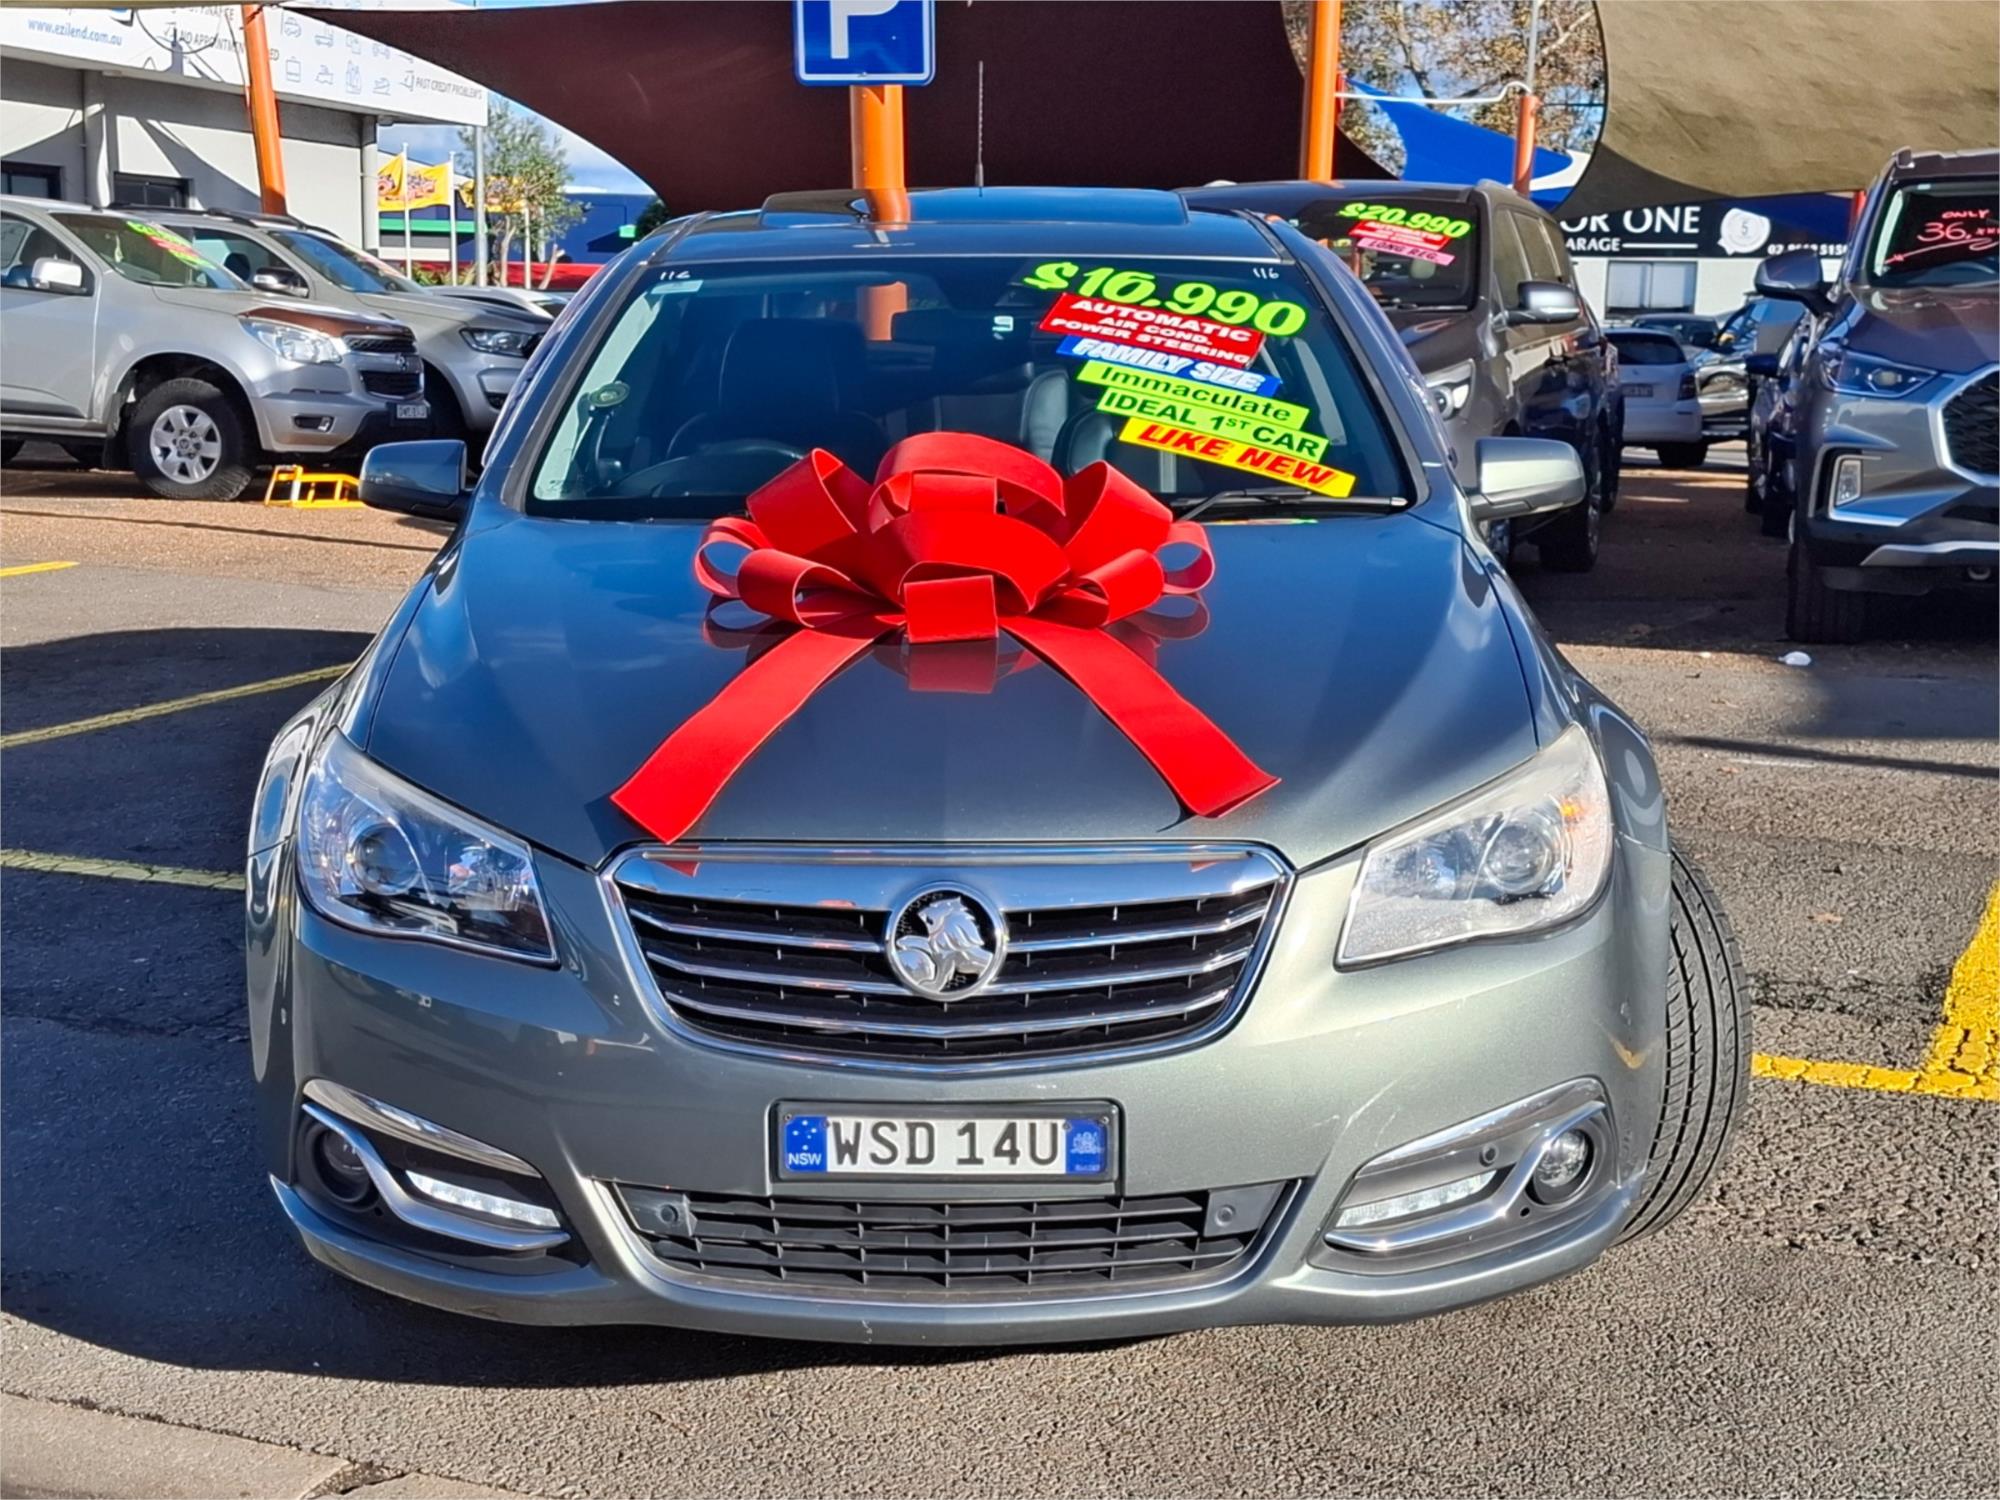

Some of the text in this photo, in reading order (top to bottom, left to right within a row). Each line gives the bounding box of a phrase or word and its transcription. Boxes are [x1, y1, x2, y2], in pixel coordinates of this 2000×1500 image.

[27, 19, 123, 46] www.ezilend.com.au
[1338, 202, 1471, 238] $20.990
[1623, 206, 1701, 233] ONE
[1942, 209, 1989, 218] ONLY
[1566, 237, 1620, 251] ARAGE
[1071, 299, 1252, 342] AUTOMATIC
[1100, 317, 1213, 346] AIR COND.
[1051, 318, 1250, 364] POWER STEERING
[1071, 338, 1266, 392] FAMILY SIZE
[1101, 366, 1291, 422] Immaculate
[1104, 391, 1197, 426] IDEAL
[1252, 426, 1320, 458] CAR
[1138, 424, 1334, 487] LIKE NEW
[787, 1152, 822, 1167] NSW
[832, 1121, 1058, 1167] WSD 14U
